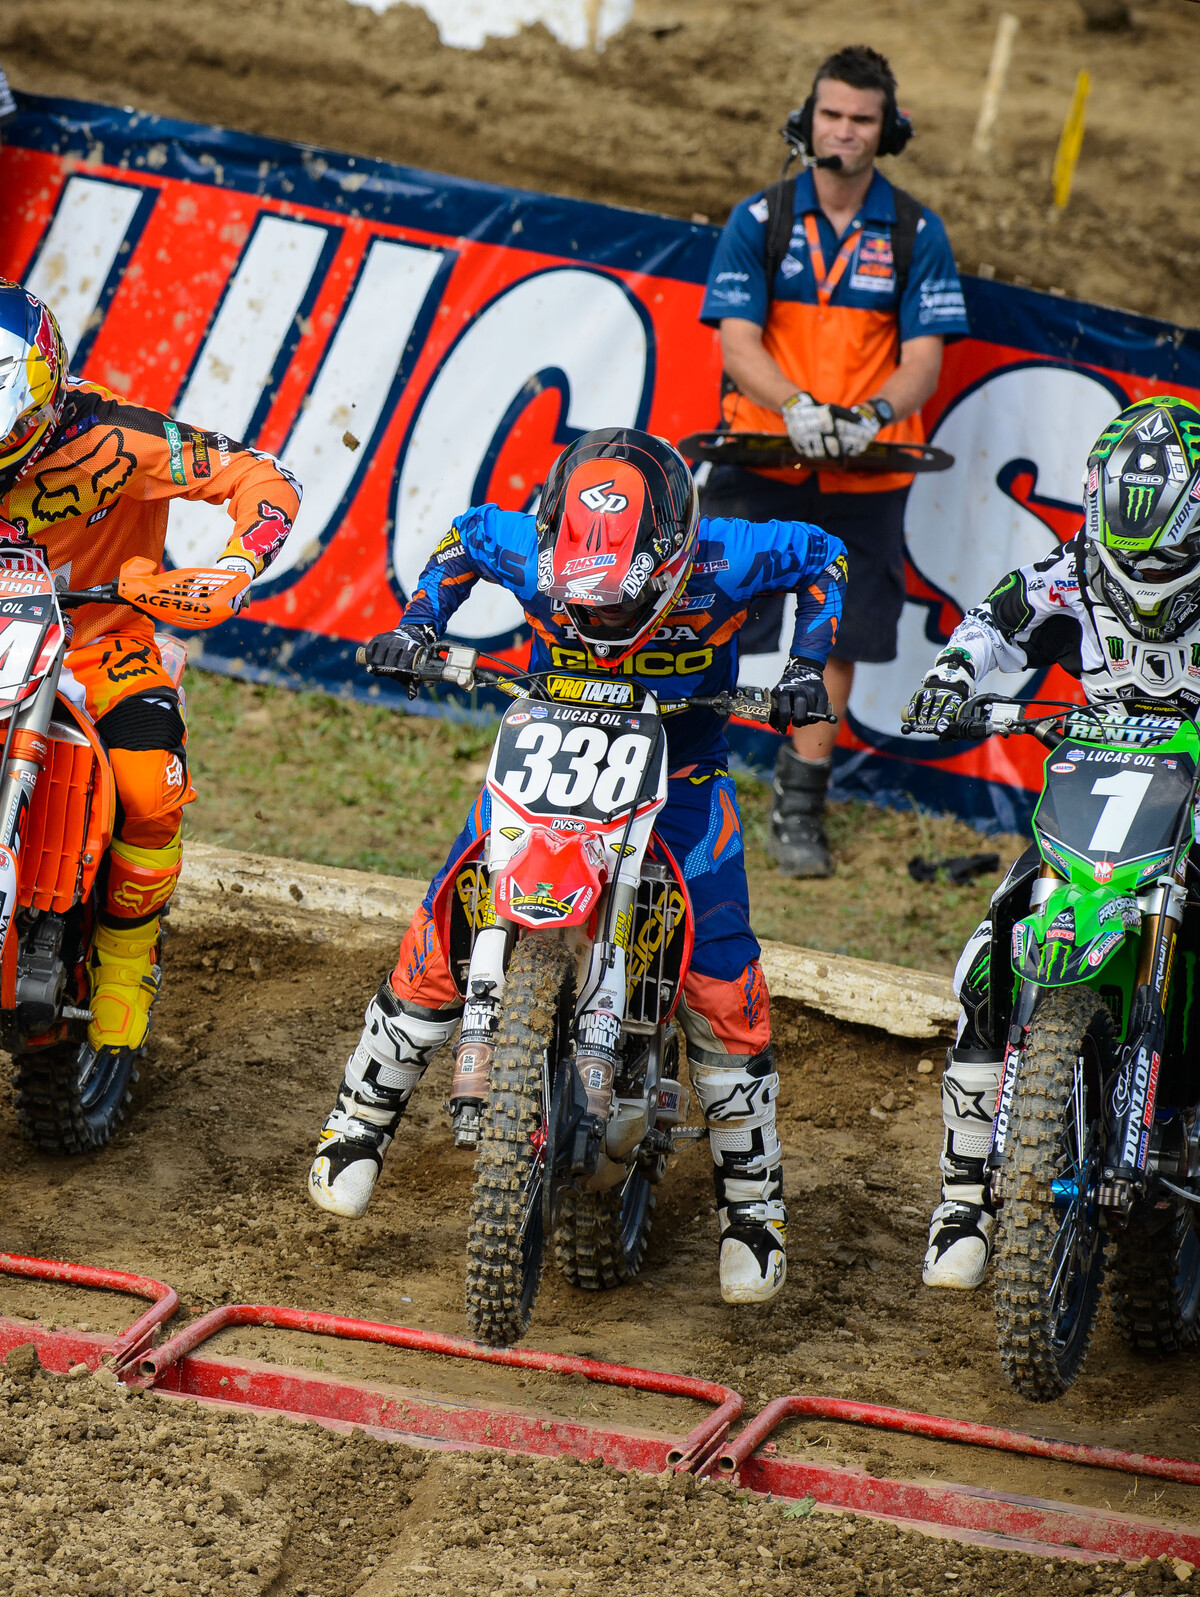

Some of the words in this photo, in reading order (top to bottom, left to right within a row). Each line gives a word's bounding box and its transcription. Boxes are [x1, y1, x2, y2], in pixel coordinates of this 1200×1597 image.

[167, 427, 183, 470] MOTOREX
[213, 432, 229, 467] ATHEN
[1124, 474, 1163, 485] OGIO
[580, 480, 628, 514] 6D
[1168, 501, 1194, 541] THOR
[1113, 538, 1145, 546] thor
[436, 545, 466, 564] MUSCLE
[539, 549, 554, 576] DVS
[561, 554, 617, 575] AMSOIL
[711, 560, 729, 569] PRO
[623, 561, 649, 598] DVS
[1055, 580, 1079, 588] PART
[564, 592, 604, 601] HONDA
[1136, 589, 1160, 597] thor
[2, 603, 24, 614] OIL
[1180, 690, 1200, 705] VANS
[553, 709, 597, 723] LUCAS
[600, 713, 621, 726] OIL
[734, 704, 770, 716] ARC
[1069, 711, 1181, 729] RENTHA
[503, 722, 652, 813] 338
[1086, 750, 1132, 764] LUCAS
[1133, 753, 1156, 767] OIL
[1088, 770, 1154, 853] 1
[552, 819, 574, 830] DVS
[499, 877, 507, 901] DUNLOP
[509, 895, 574, 915] GEICO
[578, 887, 594, 913] DUNLOP
[517, 905, 561, 917] HONDA
[1098, 901, 1116, 927] PRO
[1047, 929, 1075, 940] VANS
[463, 1013, 491, 1031] MILK
[585, 1028, 617, 1050] MILK
[1143, 1050, 1161, 1129] BRAKING
[1123, 1046, 1150, 1168] DUNLOP
